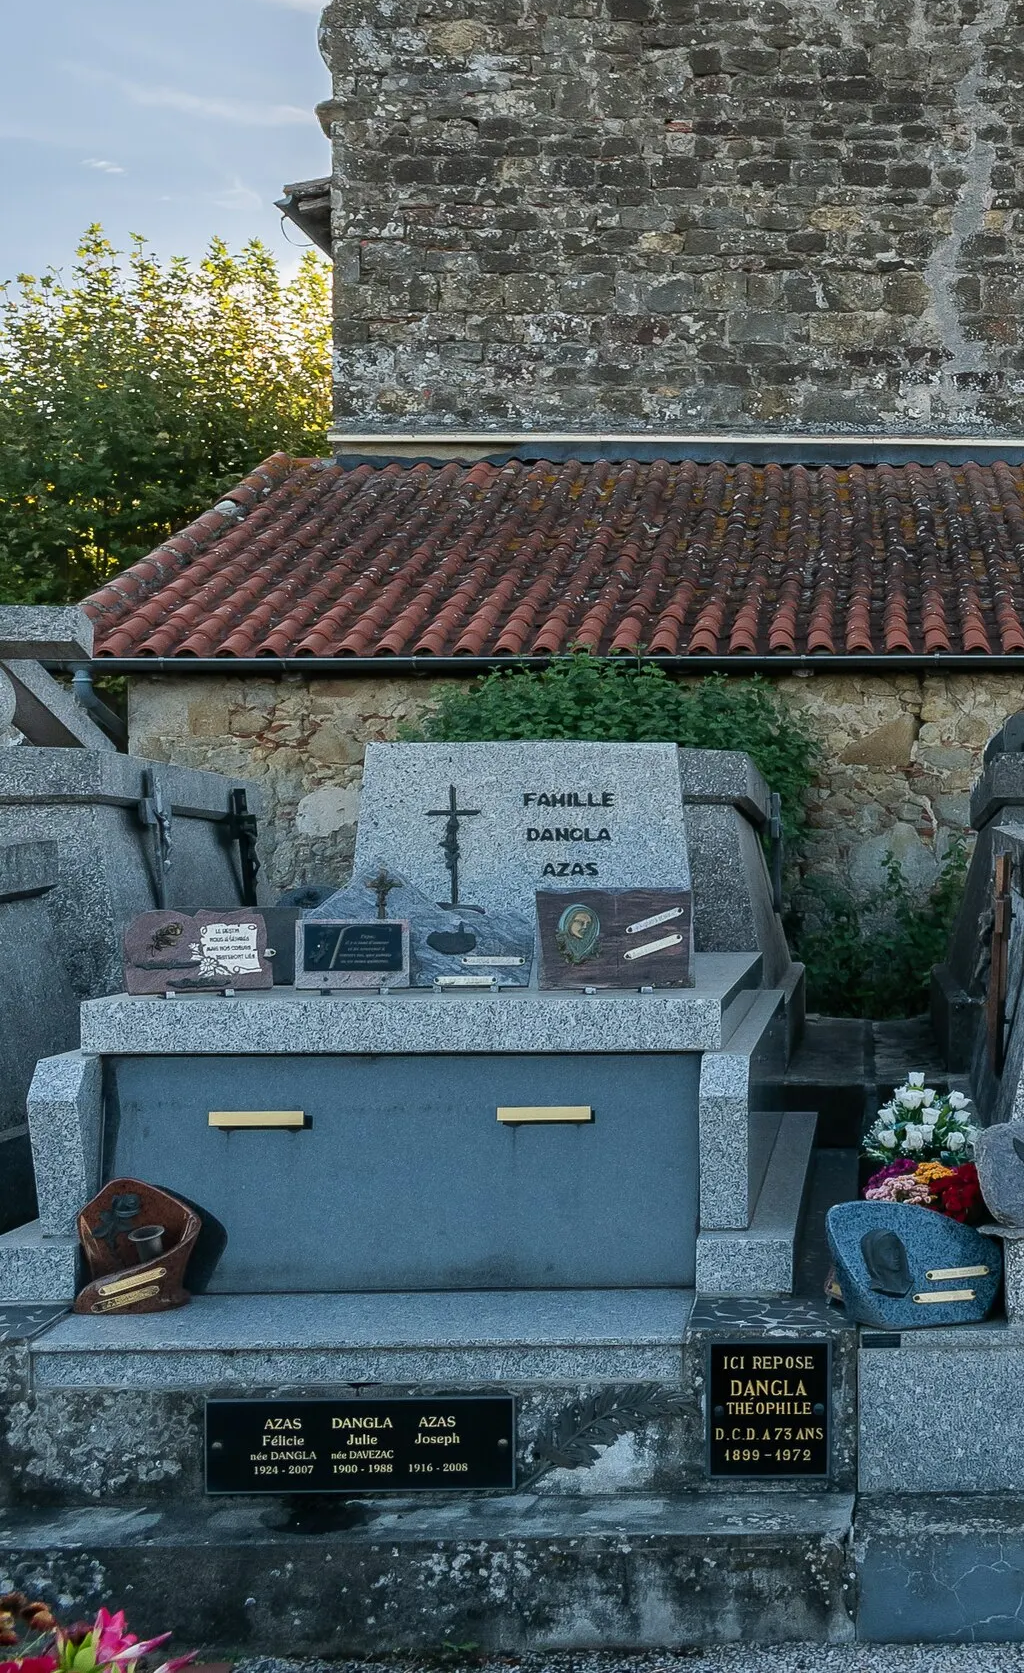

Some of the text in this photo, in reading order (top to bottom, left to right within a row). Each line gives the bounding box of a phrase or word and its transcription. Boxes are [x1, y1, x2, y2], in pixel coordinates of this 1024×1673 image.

[523, 792, 615, 807] FAMILLE
[526, 827, 612, 842] DANGLA
[542, 862, 599, 877] AZAS
[723, 1355, 815, 1369] ICI REPOSE
[730, 1379, 807, 1396] DANGLA
[726, 1397, 812, 1415] THÉOPHILE
[264, 1418, 302, 1430] AZAS
[331, 1416, 393, 1429] DANGLA
[418, 1415, 457, 1428] AZAS
[346, 1434, 378, 1445] Julie
[414, 1432, 460, 1446] Joseph
[774, 1427, 792, 1440] 73
[795, 1427, 824, 1440] ANS
[262, 1435, 305, 1446] Félicie
[250, 1450, 317, 1461] née DANGLA
[330, 1449, 394, 1459] née DAVEZAC
[724, 1449, 760, 1461] 1899
[775, 1448, 812, 1461] 1972
[254, 1465, 279, 1475] 1924
[288, 1465, 314, 1474] 2007
[332, 1464, 358, 1473] 1900
[368, 1464, 393, 1473] 1988
[408, 1463, 433, 1473] 1916
[442, 1463, 469, 1472] 2008
